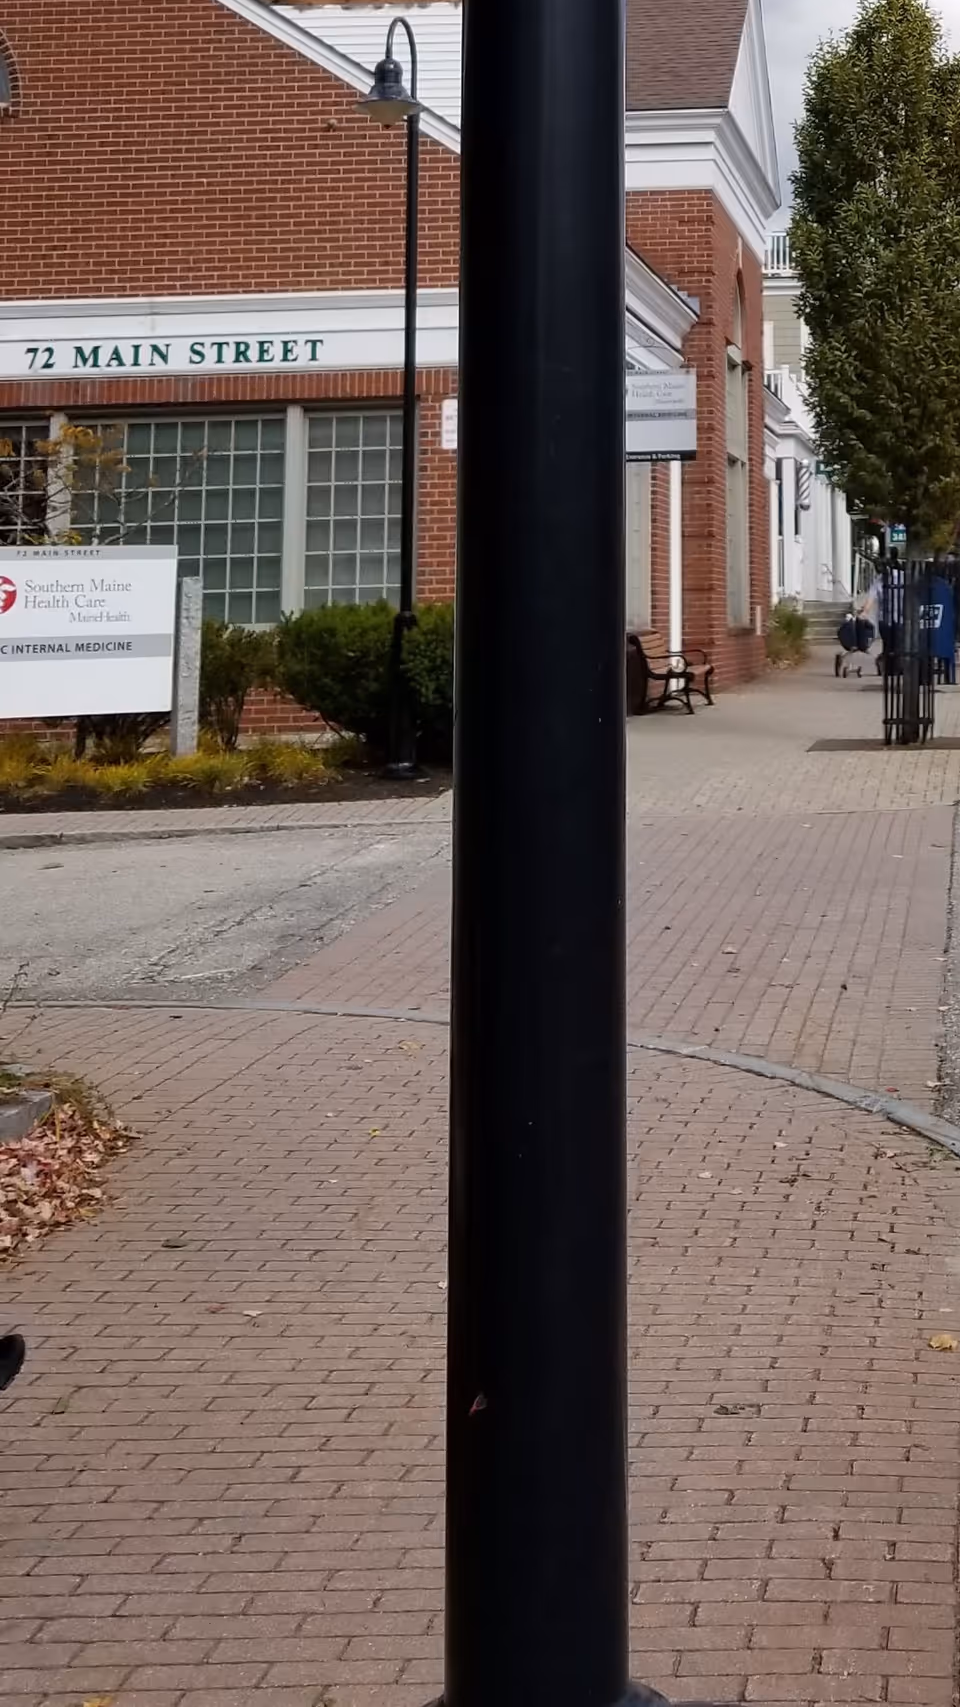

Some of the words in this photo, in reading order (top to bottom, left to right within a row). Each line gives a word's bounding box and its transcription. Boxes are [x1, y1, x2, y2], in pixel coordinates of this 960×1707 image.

[24, 346, 56, 370] 72
[72, 343, 171, 368] MAIN
[189, 339, 324, 365] STREET
[32, 549, 59, 557] MAIN
[64, 549, 101, 557] STREET
[24, 579, 85, 594] Southern
[90, 578, 132, 593] Maine
[24, 595, 69, 610] Health
[74, 594, 107, 609] Care
[11, 643, 71, 655] INTERNAL
[75, 641, 133, 653] MEDICINE
